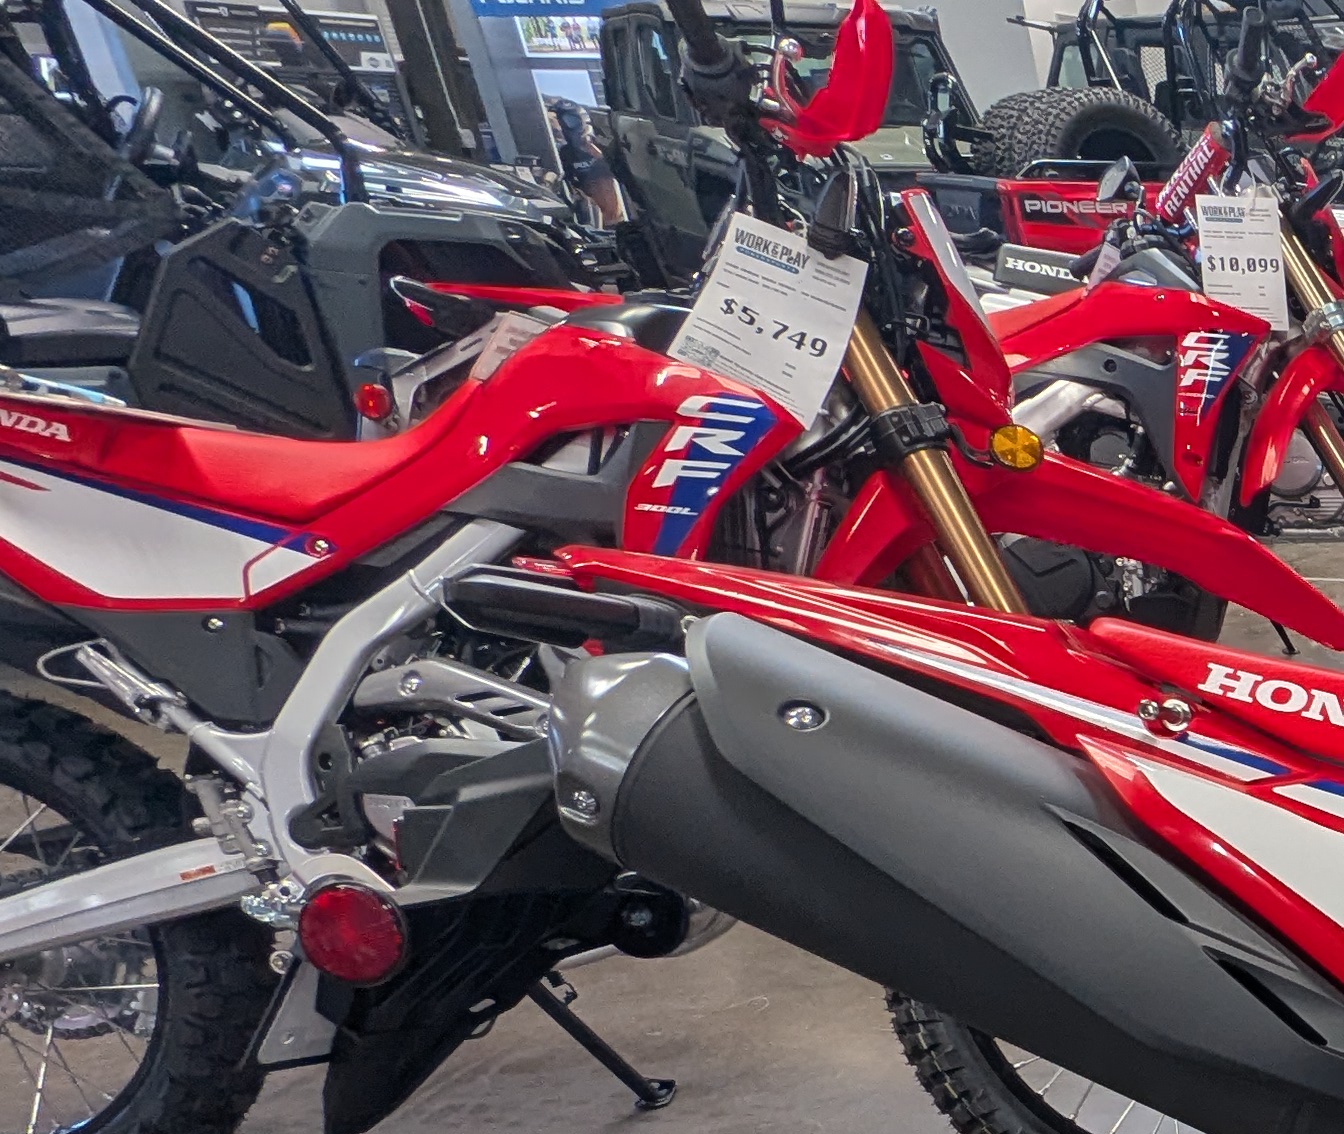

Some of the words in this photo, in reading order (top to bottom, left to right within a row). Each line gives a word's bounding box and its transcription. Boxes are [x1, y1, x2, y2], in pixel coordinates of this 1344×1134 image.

[1024, 199, 1127, 214] PIONEER
[1164, 142, 1215, 217] RENTHAL
[1207, 255, 1280, 275] $10,099
[720, 298, 828, 358] $5,749
[652, 395, 765, 488] CRF
